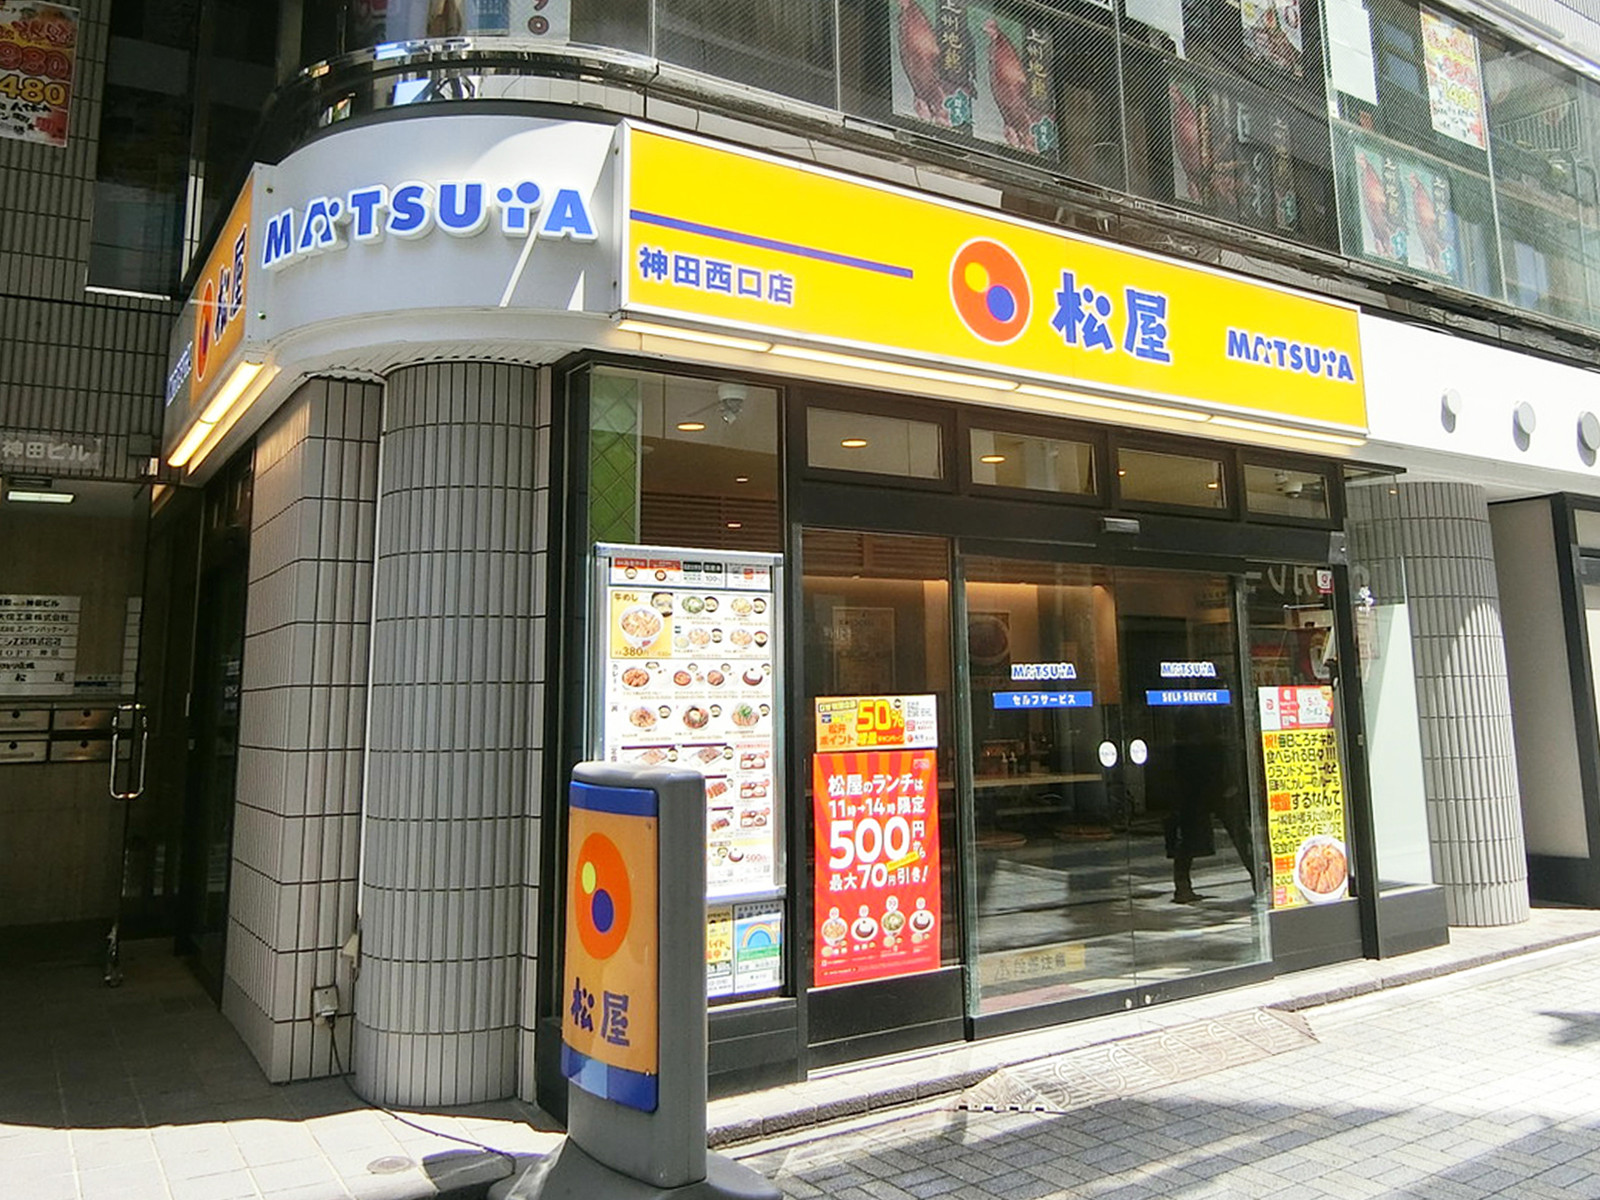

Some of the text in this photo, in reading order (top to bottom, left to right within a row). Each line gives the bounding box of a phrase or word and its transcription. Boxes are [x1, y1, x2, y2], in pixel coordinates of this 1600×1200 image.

[639, 247, 793, 304] 神田西口店
[1051, 272, 1171, 362] 松屋
[2, 440, 91, 461] 神田ビル
[1012, 694, 1077, 705] セルフサービス
[1161, 691, 1218, 703] SELF SERVICE
[820, 735, 854, 746] ポイント
[828, 774, 924, 797] 松屋のランチは
[571, 976, 631, 1047] 松屋
